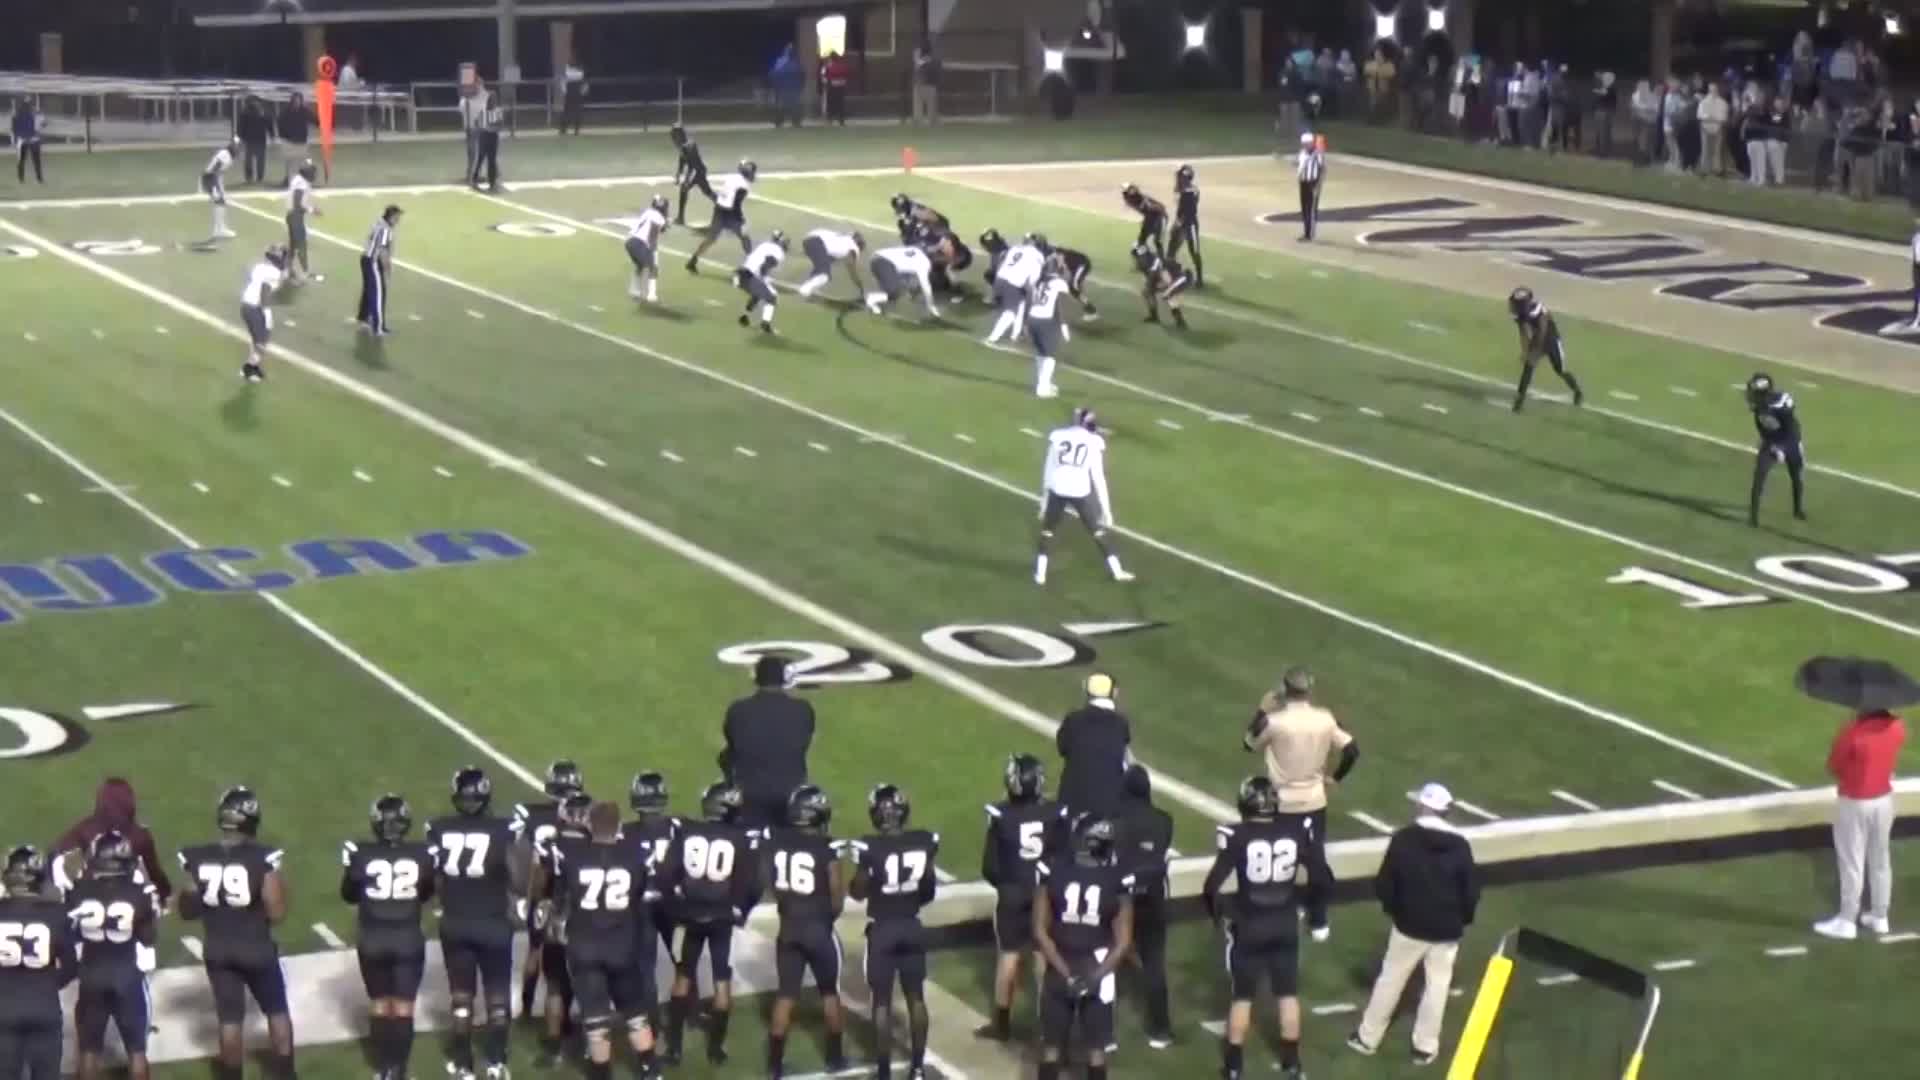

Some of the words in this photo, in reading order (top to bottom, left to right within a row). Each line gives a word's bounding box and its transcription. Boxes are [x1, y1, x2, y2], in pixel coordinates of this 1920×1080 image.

[1058, 440, 1089, 467] 20
[1606, 554, 1910, 609] 10
[717, 622, 1077, 684] 20
[441, 832, 491, 876] 77
[1018, 822, 1043, 859] 5
[1245, 839, 1297, 883] 82
[198, 864, 252, 907] 79
[365, 859, 419, 900] 32
[578, 867, 631, 910] 72
[774, 850, 815, 895] 16
[883, 850, 927, 894] 17
[80, 899, 134, 941] 23
[1060, 882, 1101, 926] 11
[0, 922, 51, 968] 53
